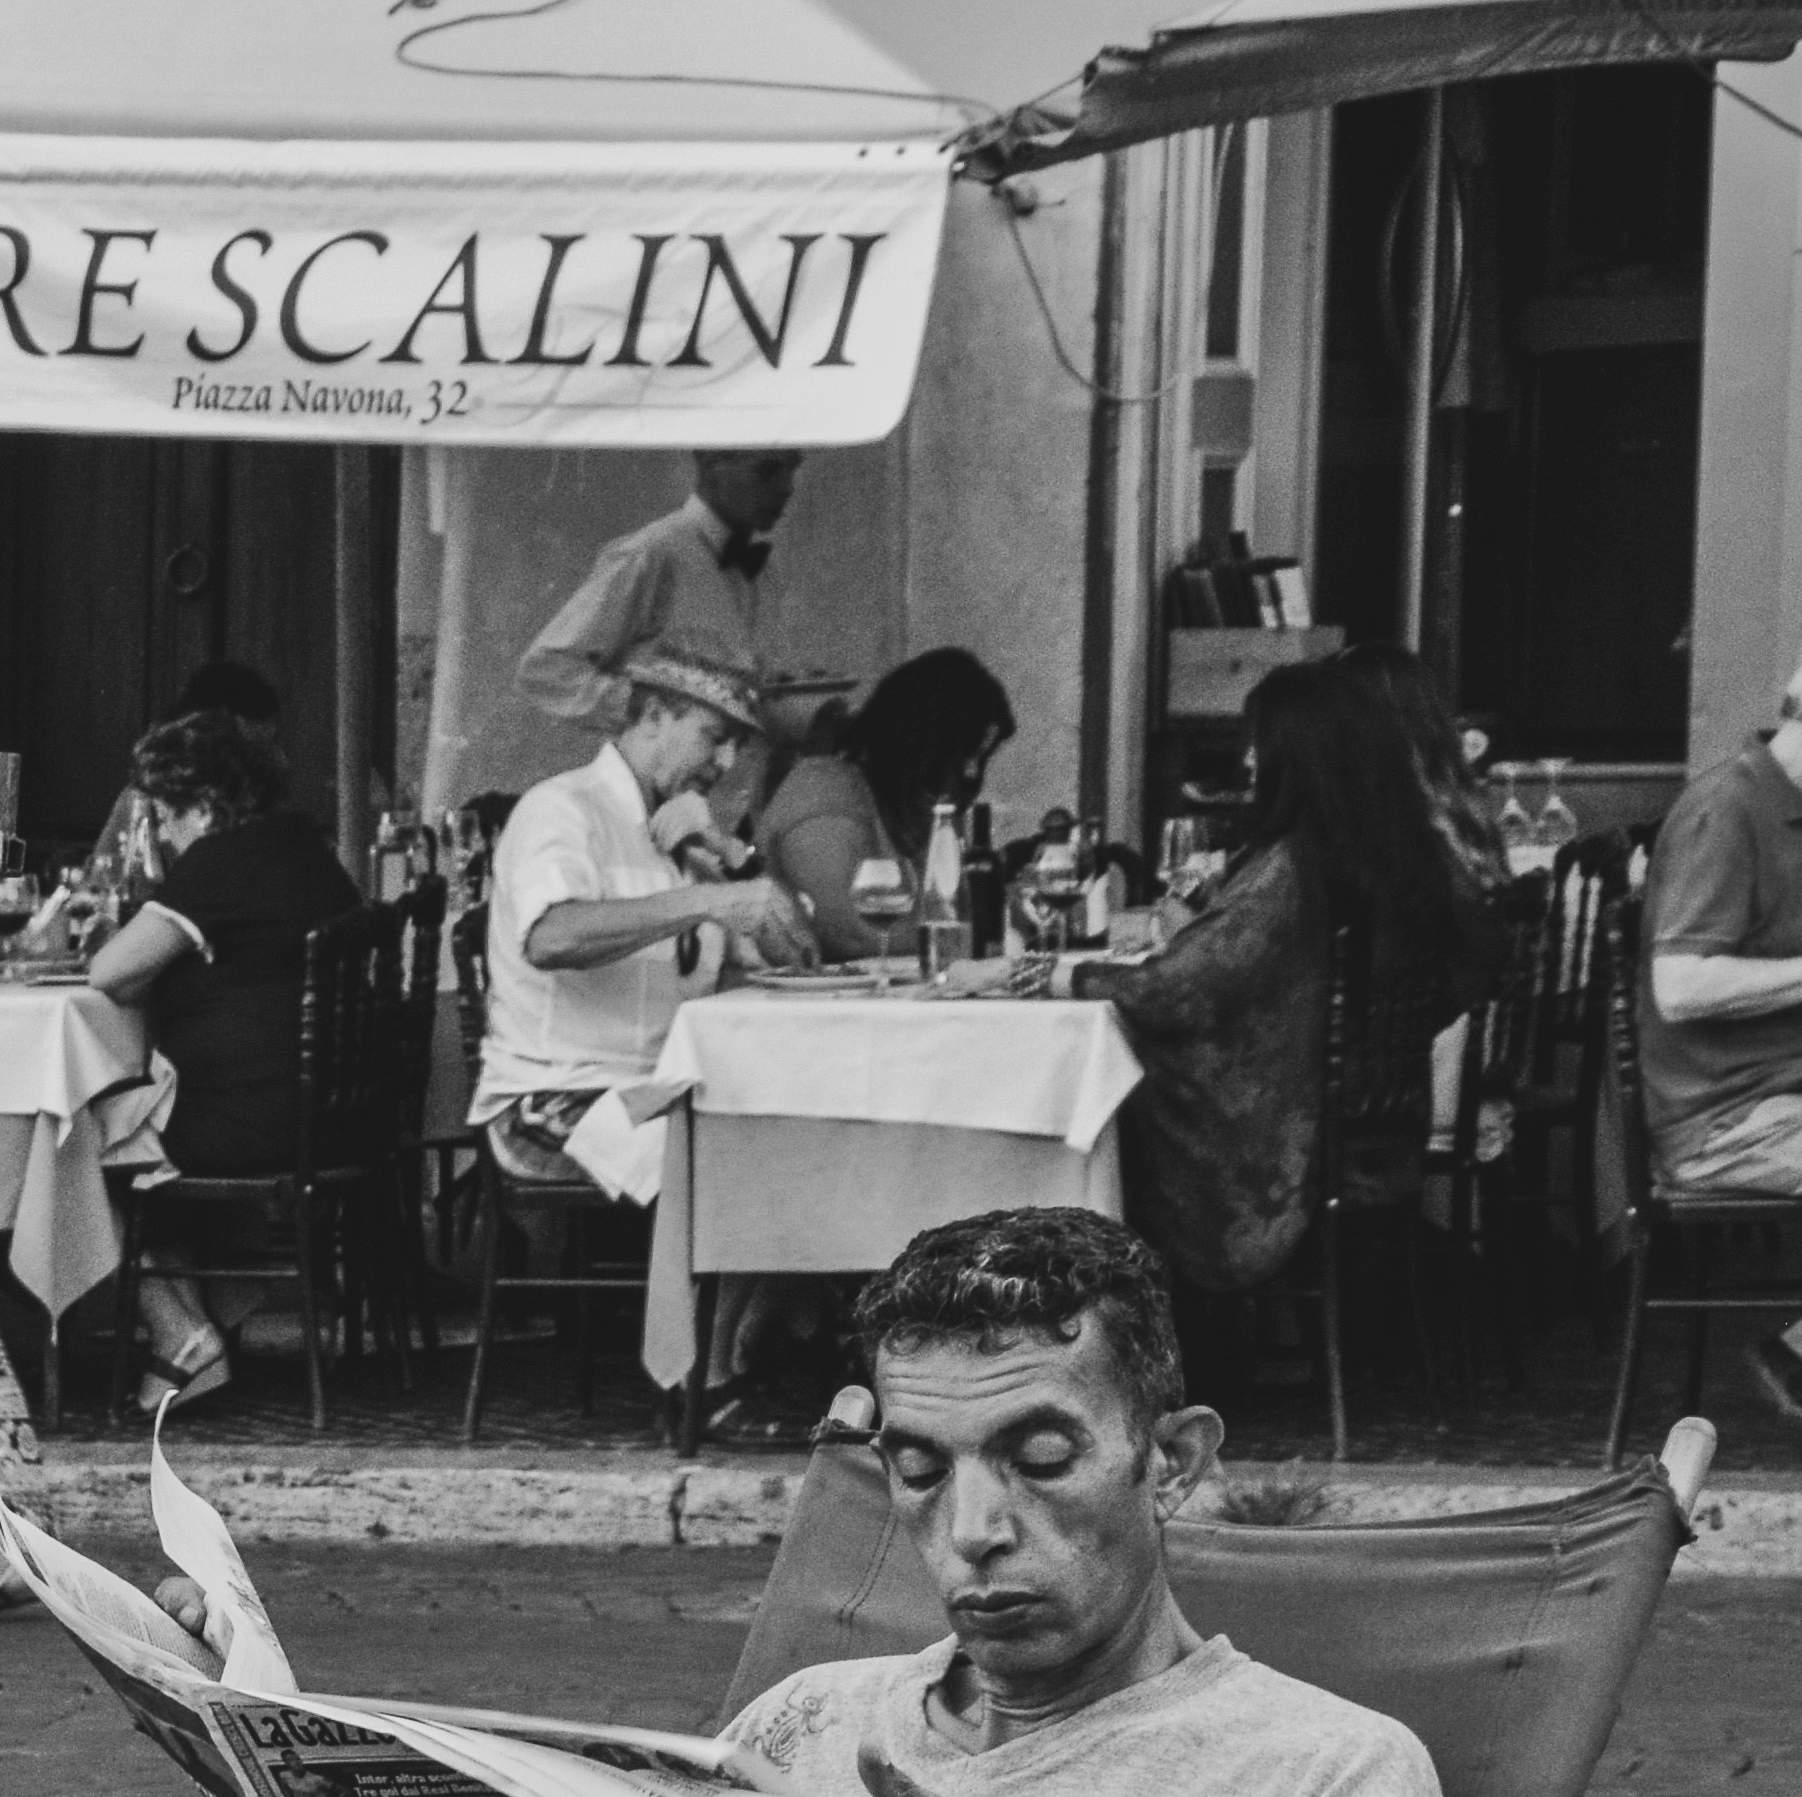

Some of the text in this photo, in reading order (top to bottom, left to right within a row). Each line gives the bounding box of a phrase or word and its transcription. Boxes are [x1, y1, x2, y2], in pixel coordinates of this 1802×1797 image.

[185, 228, 889, 369] SCALINI
[171, 372, 468, 425] Piazza Navona, 32
[353, 1786, 378, 1797] Tre
